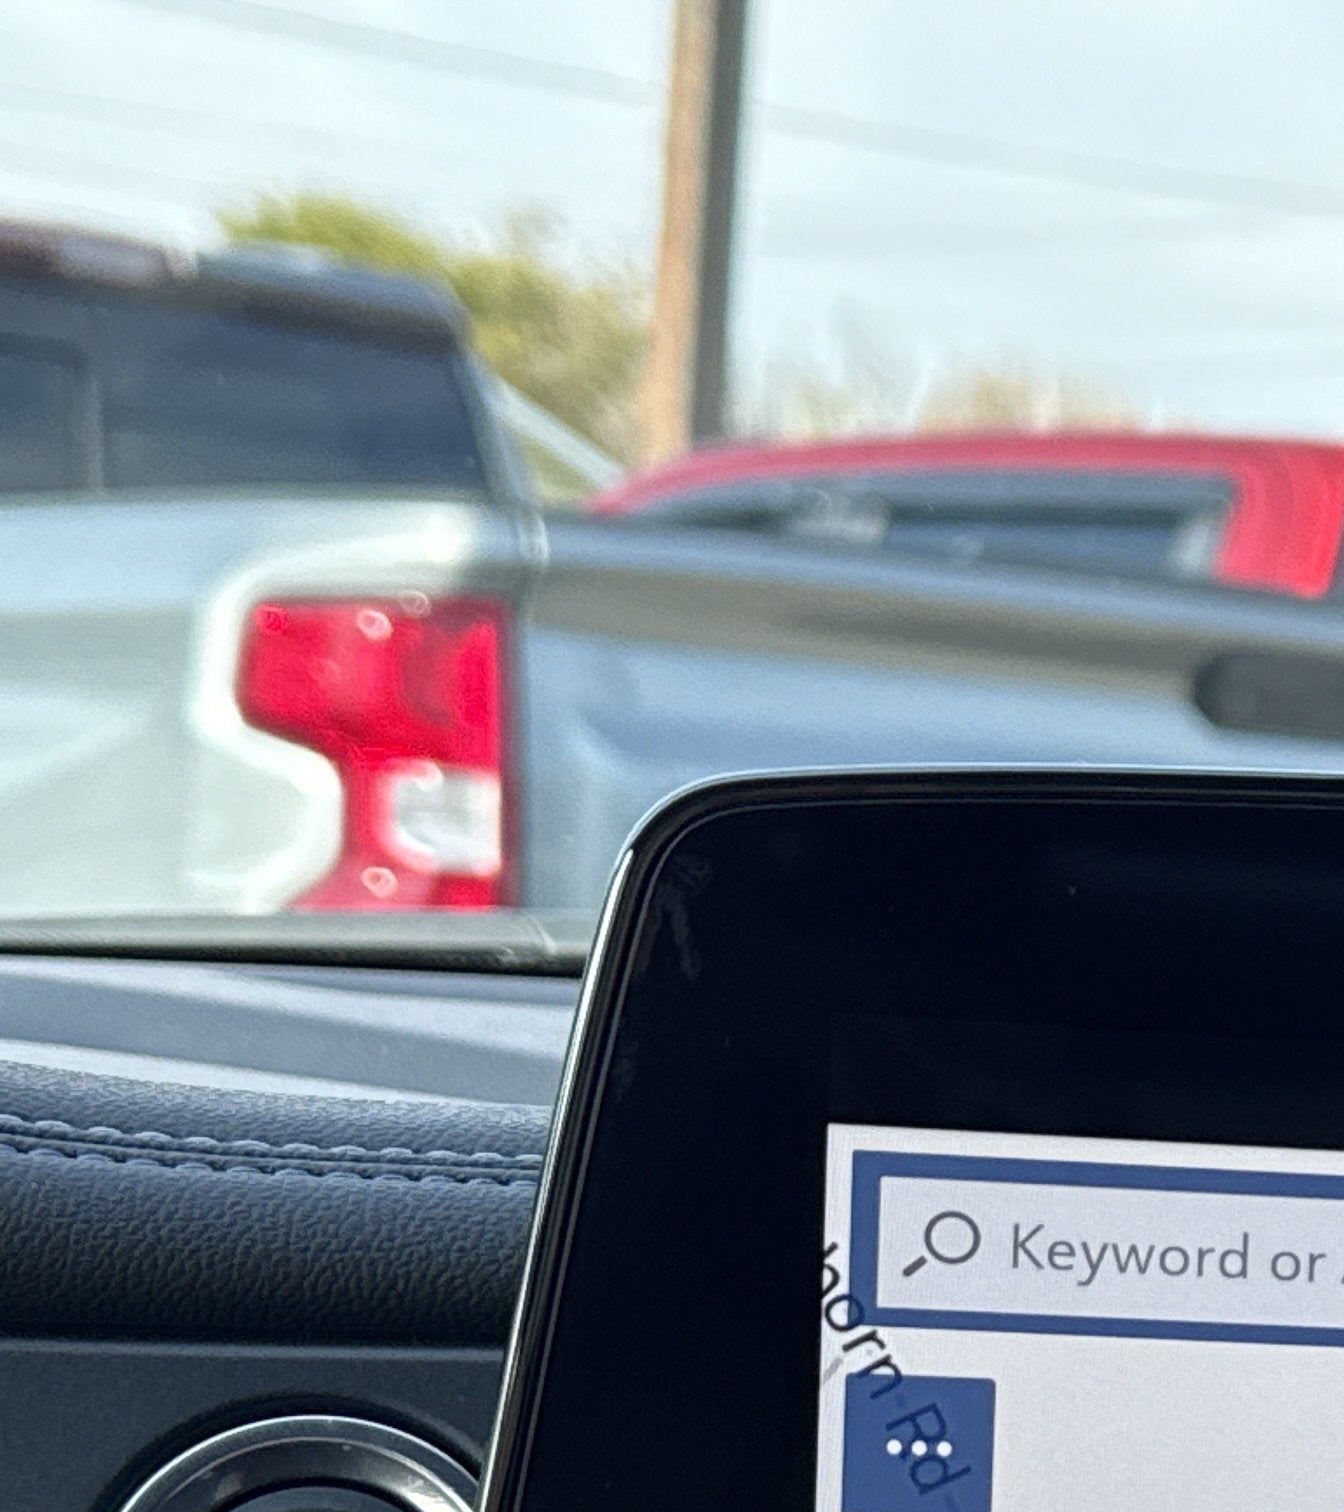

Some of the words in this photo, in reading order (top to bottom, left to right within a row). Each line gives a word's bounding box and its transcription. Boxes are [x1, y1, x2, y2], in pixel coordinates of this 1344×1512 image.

[1011, 1223, 1250, 1287] Keyword
[1270, 1243, 1326, 1281] or
[885, 1402, 972, 1495] Rd
